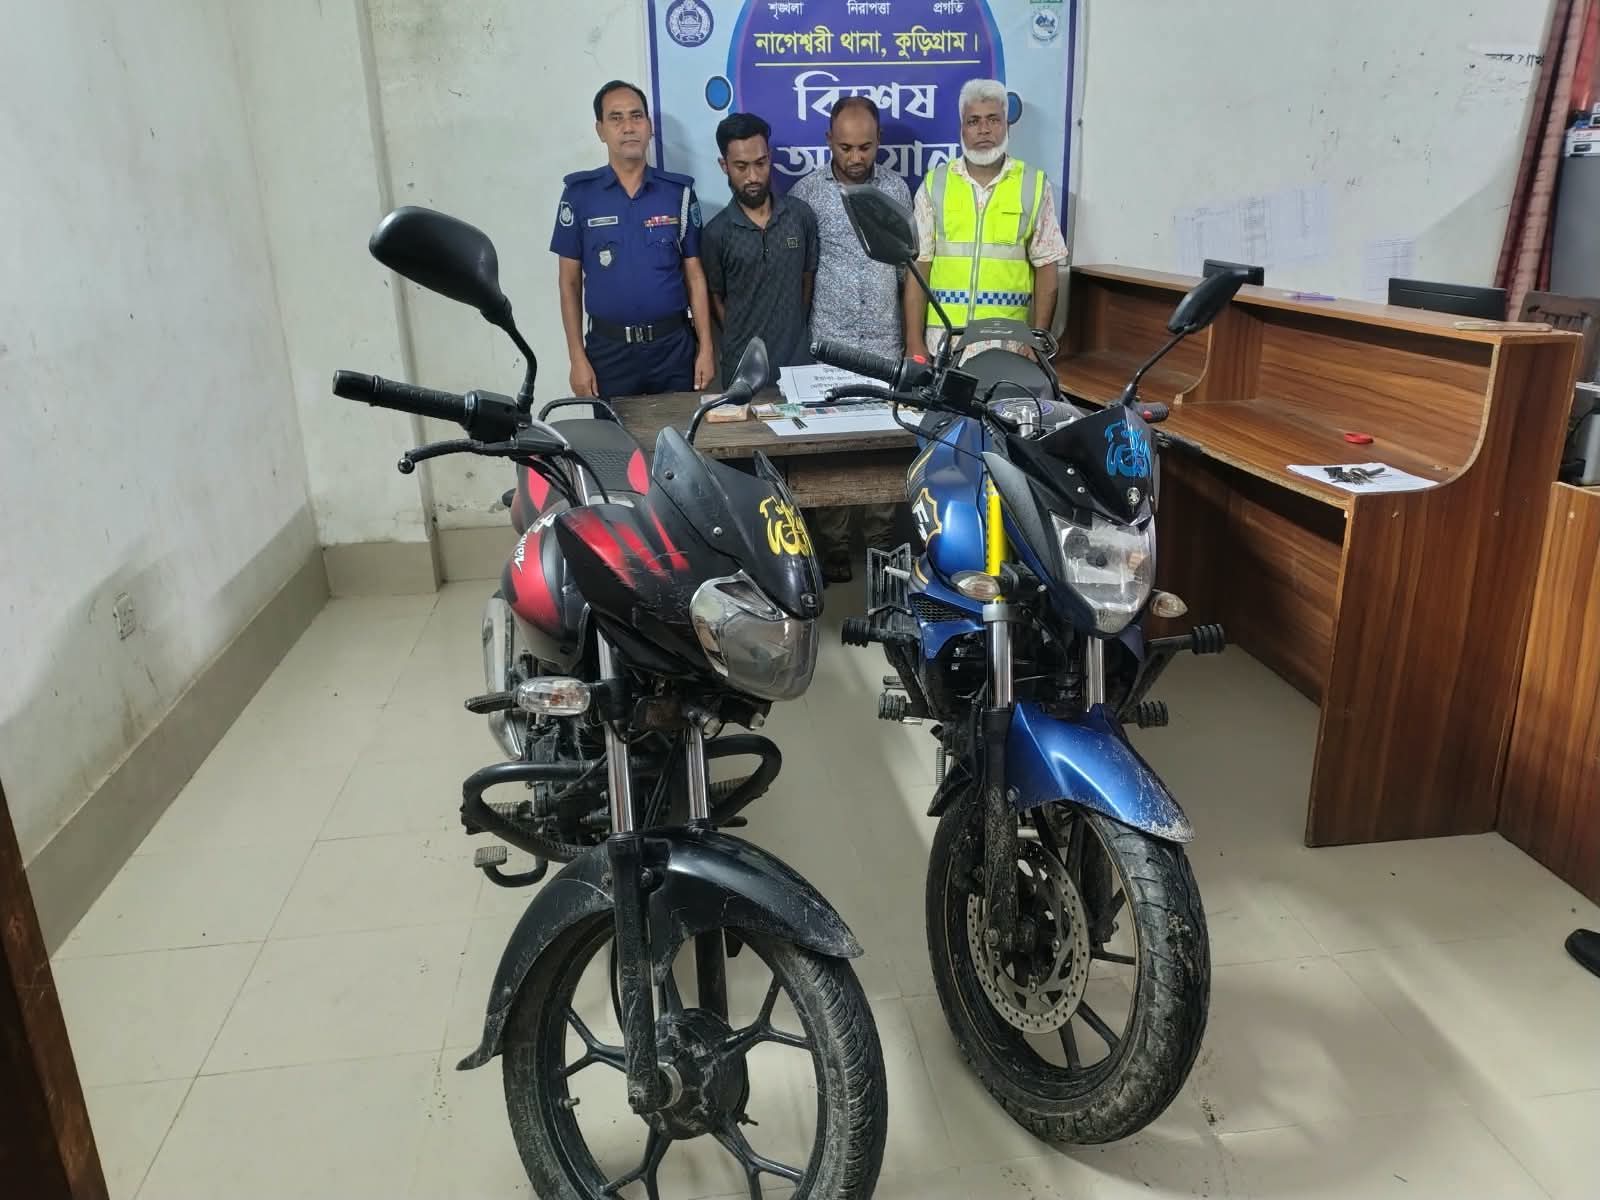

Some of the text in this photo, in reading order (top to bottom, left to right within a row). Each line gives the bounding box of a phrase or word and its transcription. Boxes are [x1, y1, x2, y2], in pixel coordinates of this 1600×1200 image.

[767, 0, 966, 20] শৃঙ্খলা নিরাপত্তা প্রগতি
[753, 25, 834, 54] নাগেশ্বরী
[840, 30, 887, 57] থানা,
[773, 140, 960, 177] অযান
